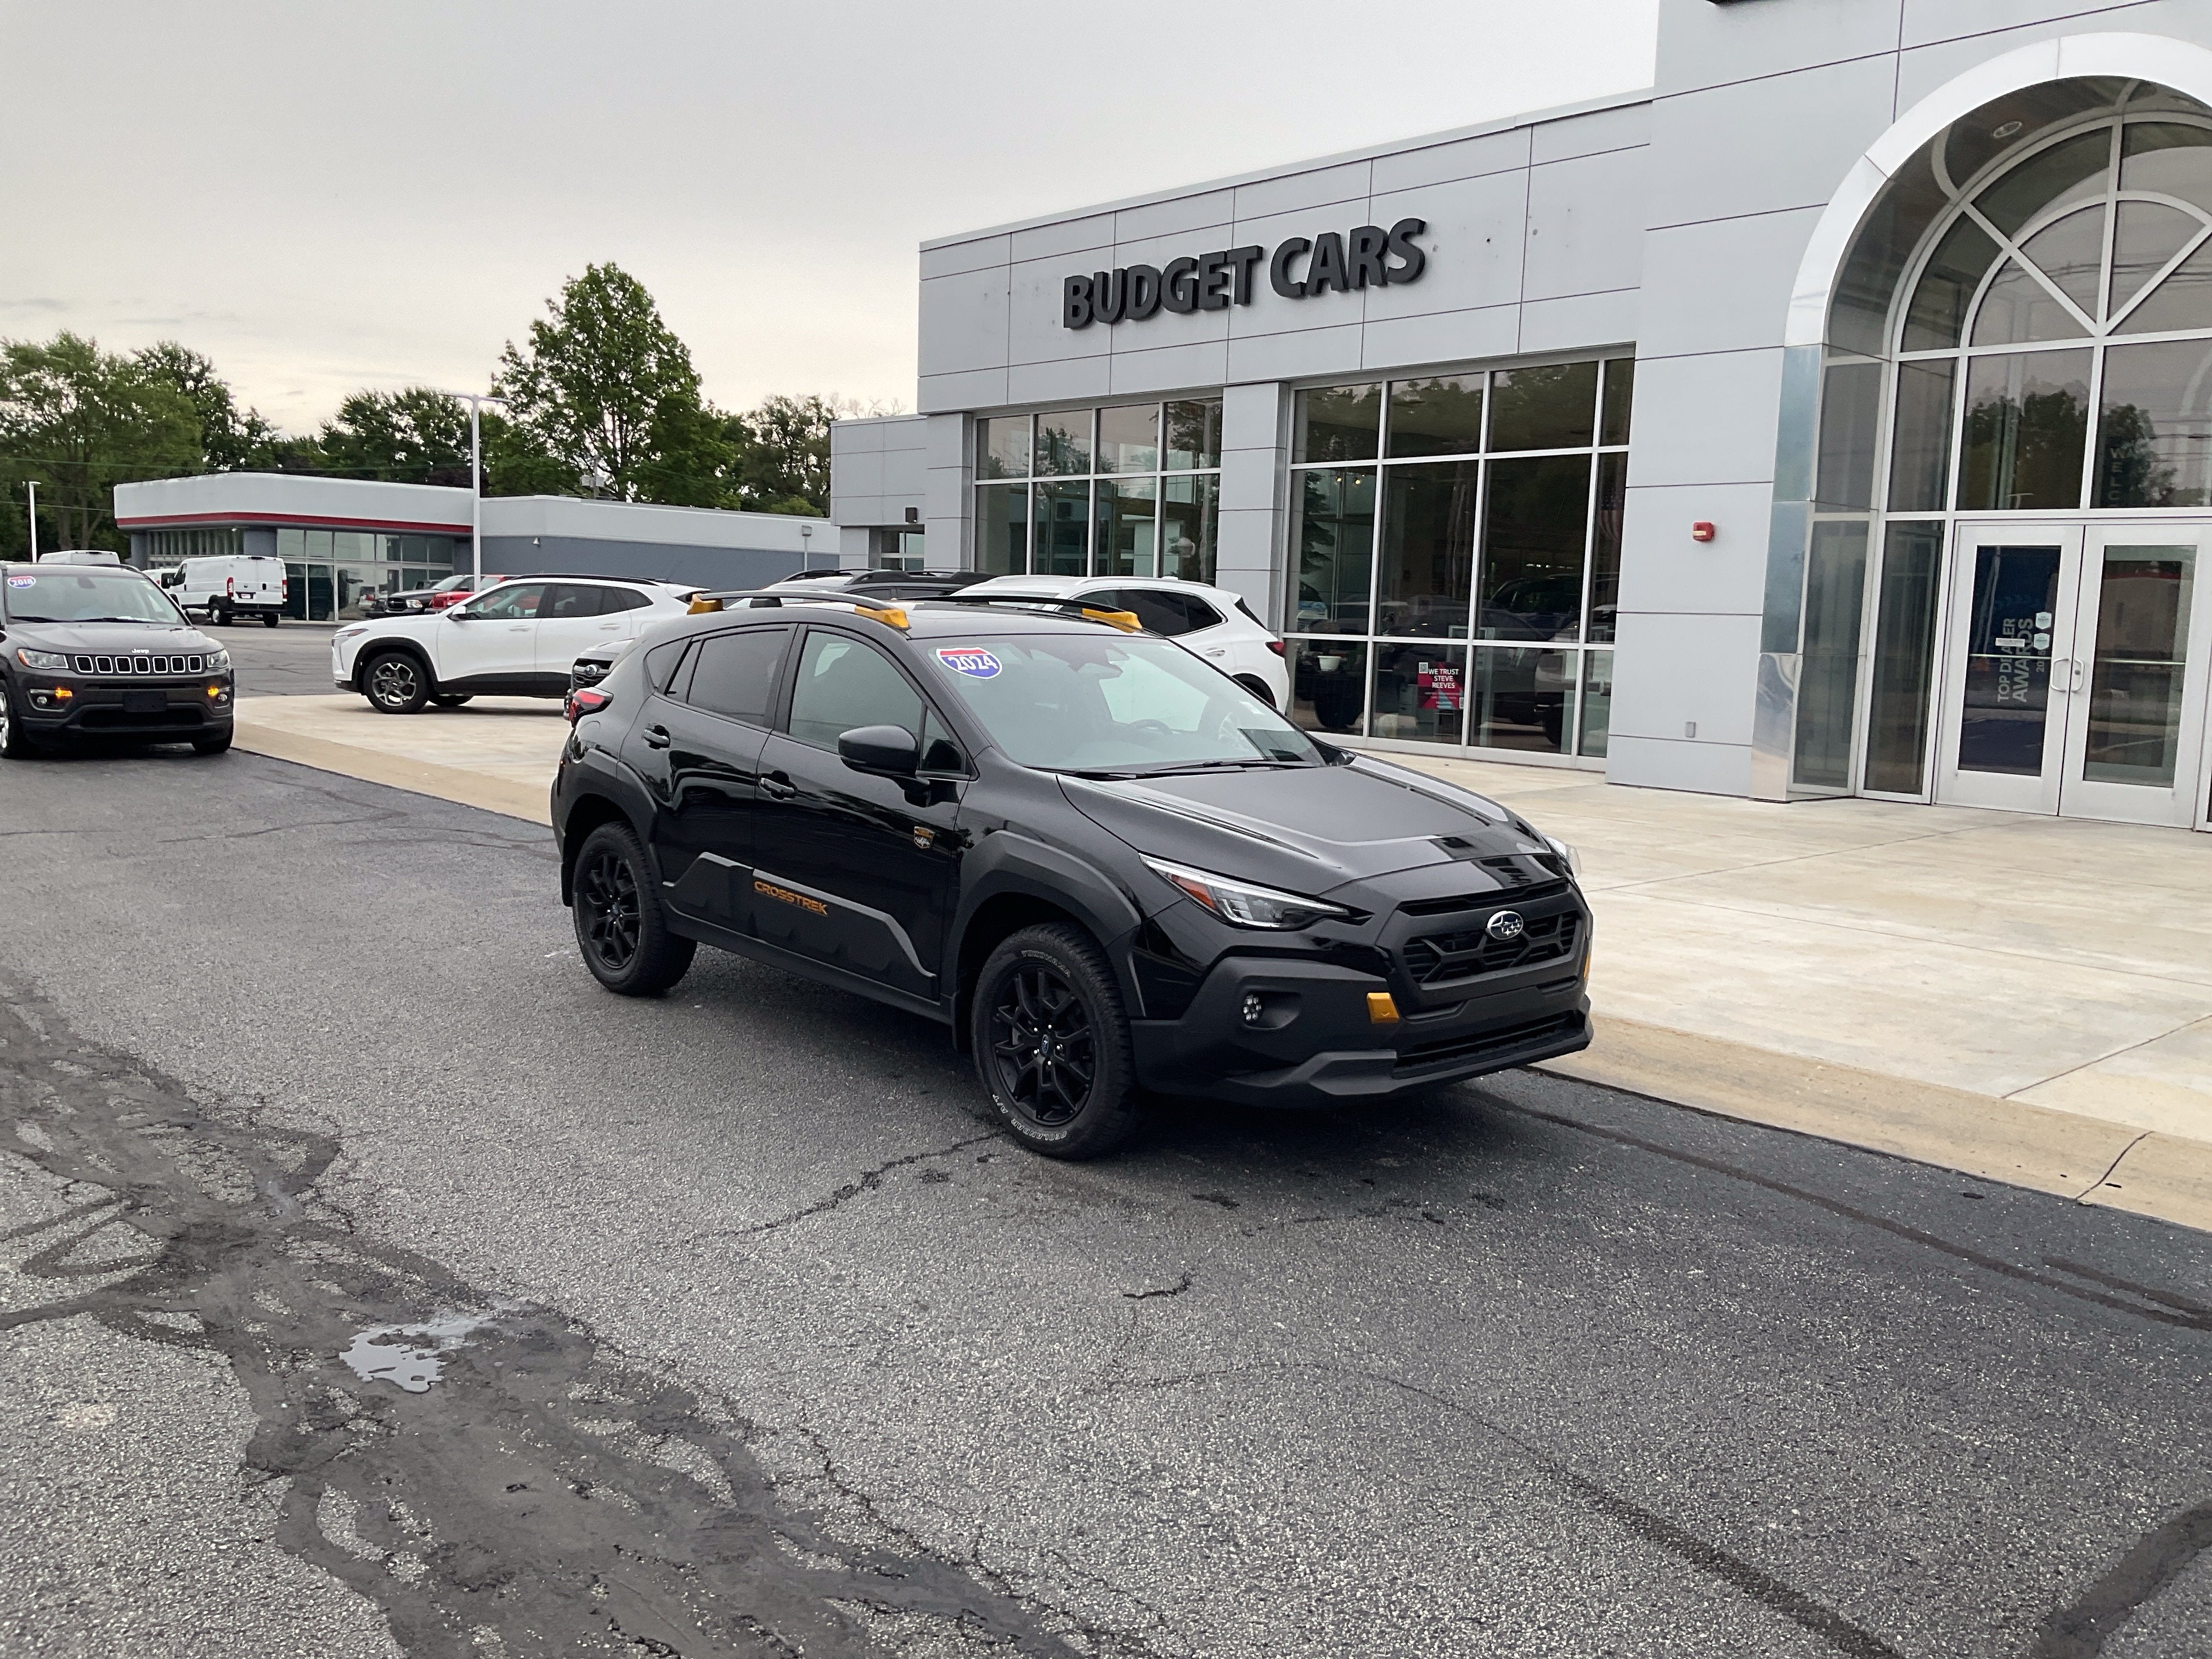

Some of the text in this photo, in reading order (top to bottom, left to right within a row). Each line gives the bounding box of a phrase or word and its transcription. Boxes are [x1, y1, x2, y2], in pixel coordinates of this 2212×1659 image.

[1063, 218, 1426, 329] BUDGET CARS
[2108, 447, 2126, 507] WELC
[2000, 618, 2016, 672] DEAER
[948, 656, 998, 670] 2024
[1997, 676, 2010, 702] TOP
[754, 881, 827, 915] CROSSTREK
[1011, 1118, 1066, 1141] GEOLANDAR
